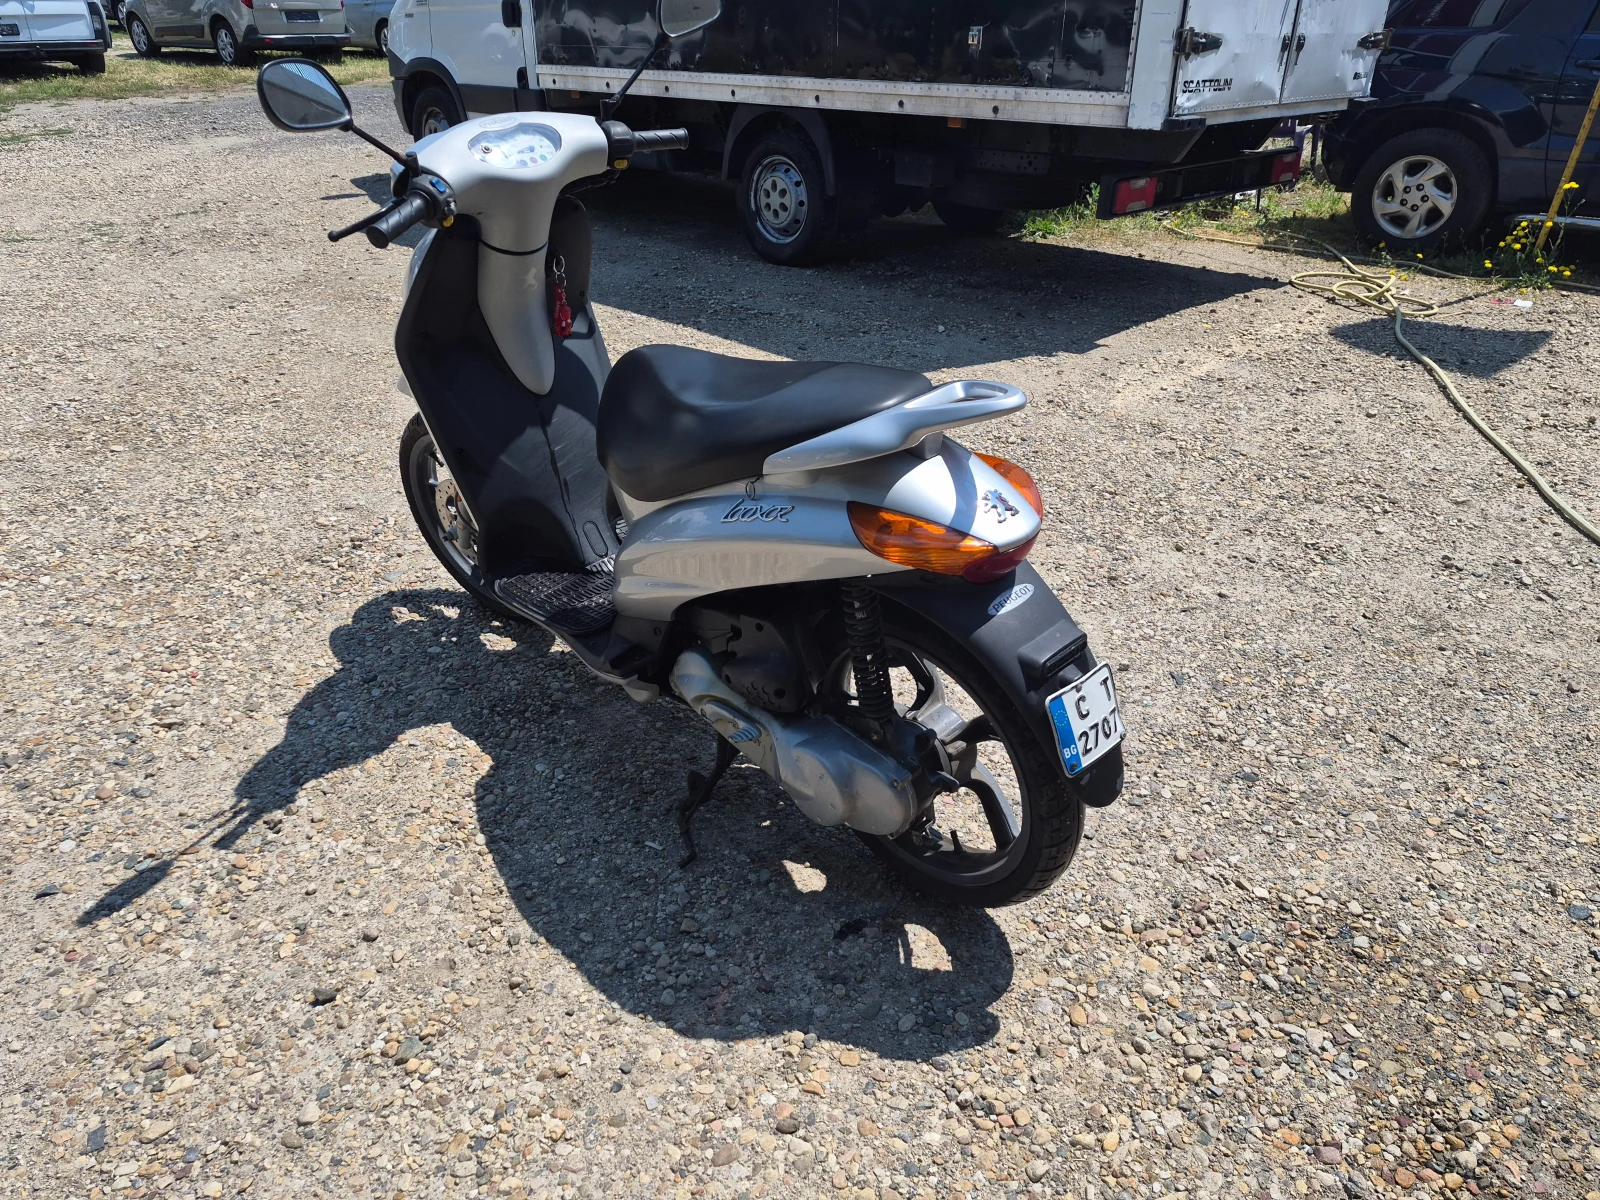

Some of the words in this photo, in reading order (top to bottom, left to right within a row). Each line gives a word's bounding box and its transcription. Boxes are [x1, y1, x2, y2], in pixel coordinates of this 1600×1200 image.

[992, 585, 1031, 613] PEUGEOT
[1075, 694, 1090, 720] C
[1100, 676, 1112, 701] T
[1077, 706, 1118, 757] 2707
[1063, 744, 1078, 759] BG
